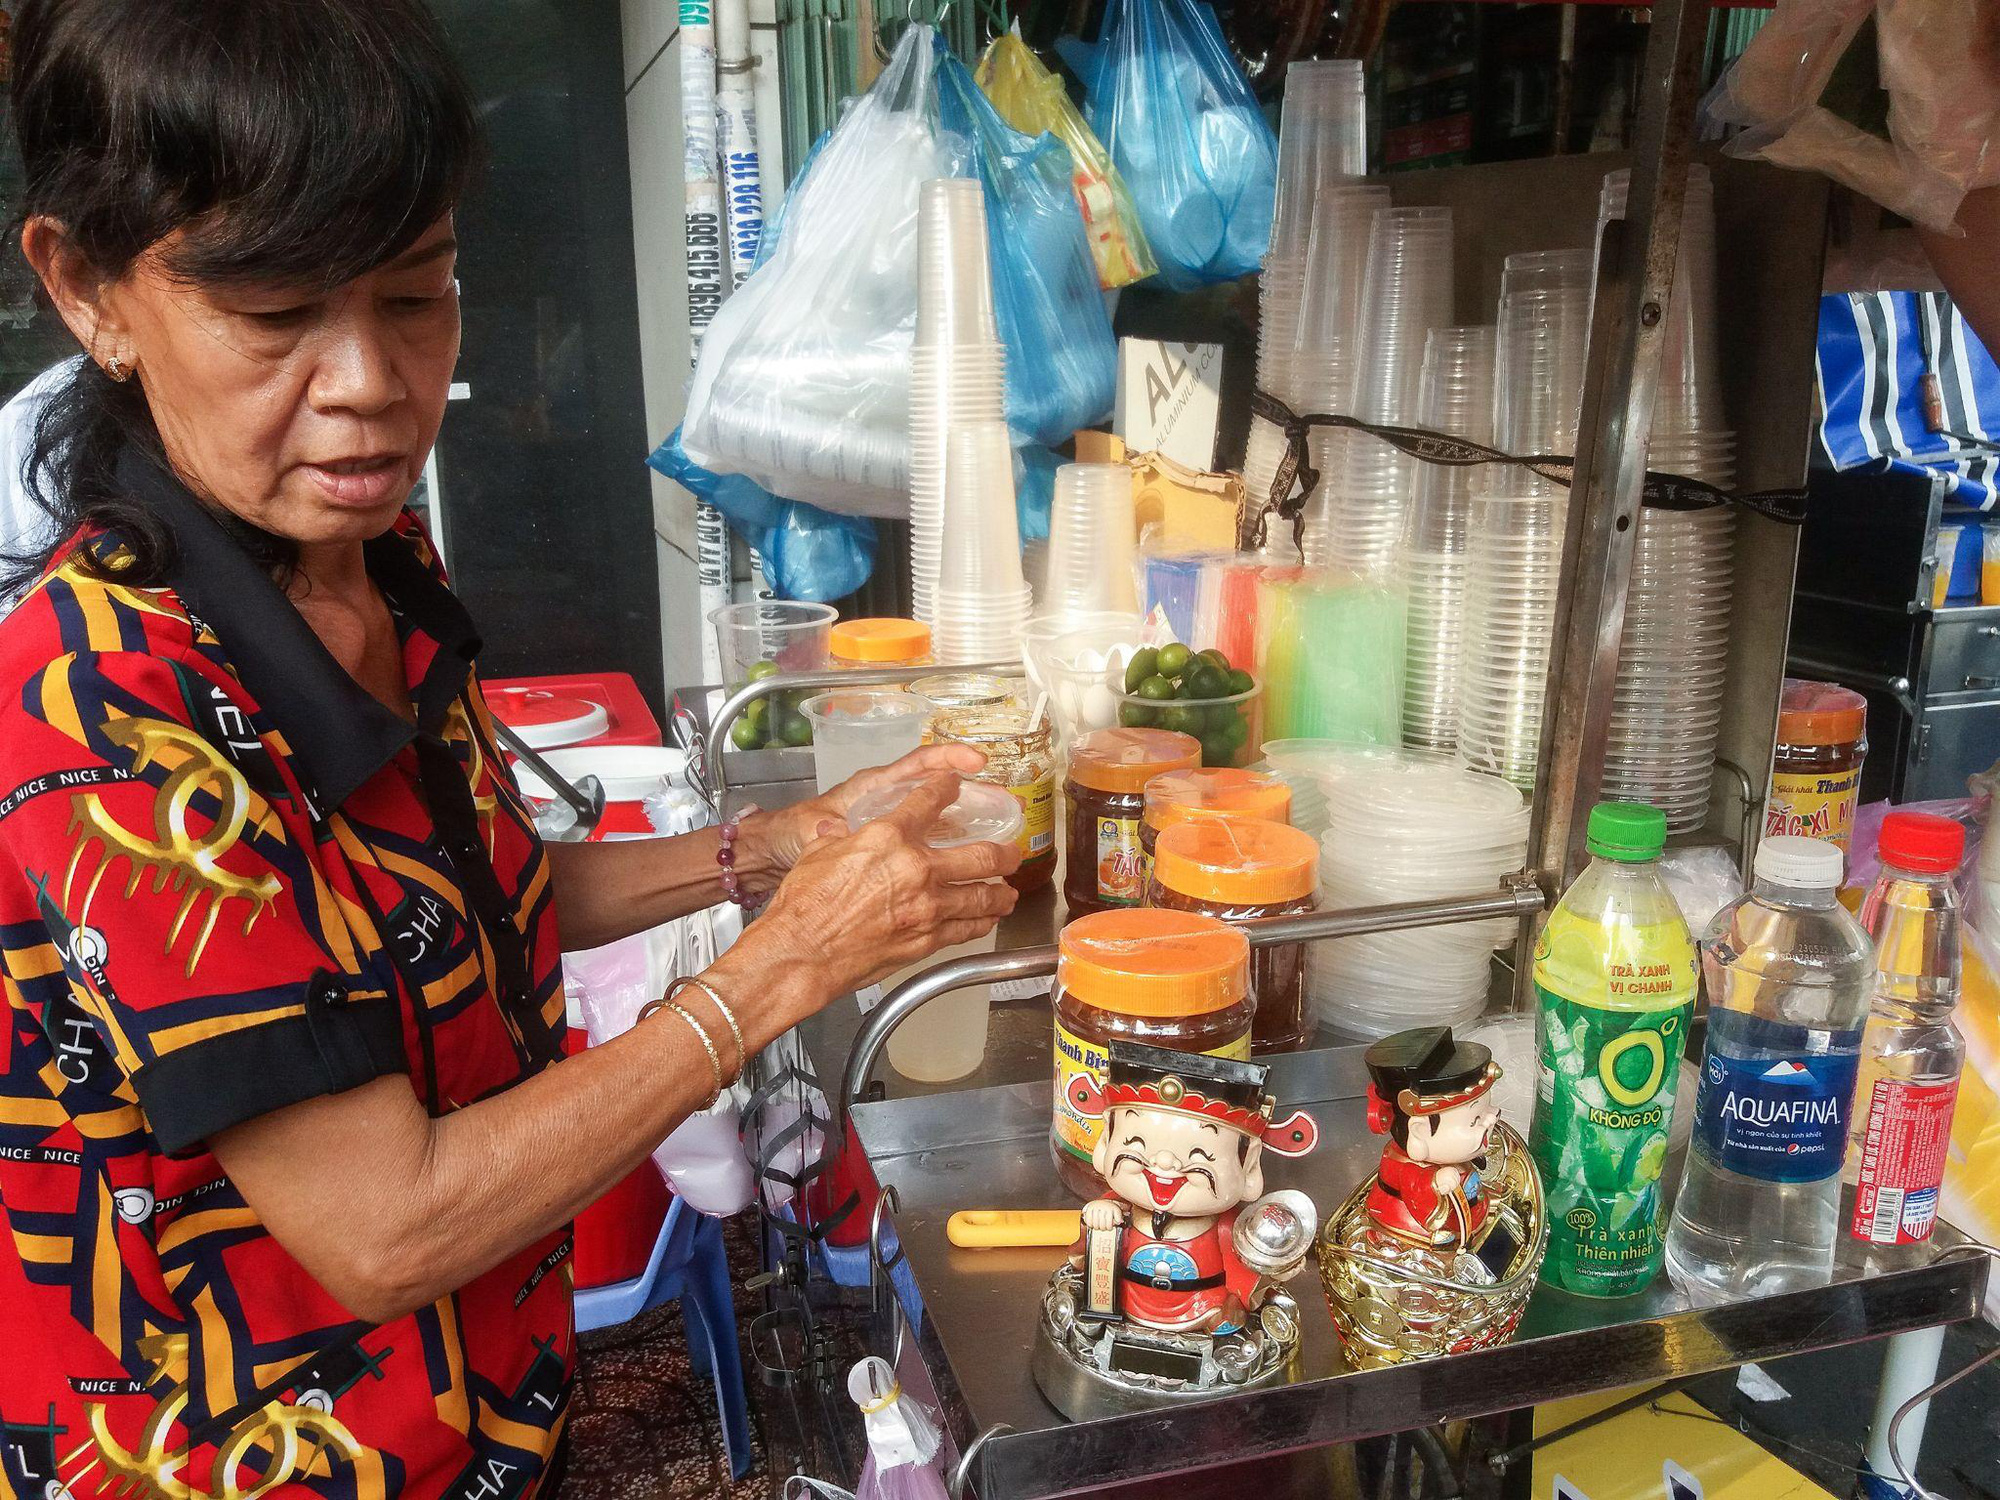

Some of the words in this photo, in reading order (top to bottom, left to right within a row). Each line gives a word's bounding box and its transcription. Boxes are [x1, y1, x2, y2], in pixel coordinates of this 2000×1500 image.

[15, 778, 48, 803] NICE
[60, 769, 101, 785] NICE
[1816, 777, 1852, 794] Thanh
[397, 895, 444, 963] CHA
[1610, 963, 1634, 977] TRÀ
[1639, 964, 1670, 977] XANH
[1610, 981, 1624, 995] VỊ
[1628, 980, 1672, 994] CHANH
[1720, 1090, 1841, 1127] AQUAFINA
[1589, 1106, 1641, 1130] KHÔNG
[1642, 1105, 1662, 1127] ĐỘ
[44, 1150, 81, 1164] NICE
[1800, 1143, 1825, 1154] pepsi
[1570, 1213, 1594, 1224] 100%
[1578, 1225, 1607, 1241] Trà
[1618, 1222, 1653, 1241] xanh
[548, 1243, 569, 1266] NICE
[1576, 1243, 1617, 1260] Thiên
[1621, 1244, 1654, 1260] nhiên
[80, 1380, 118, 1392] NICE
[464, 1459, 518, 1500] HA
